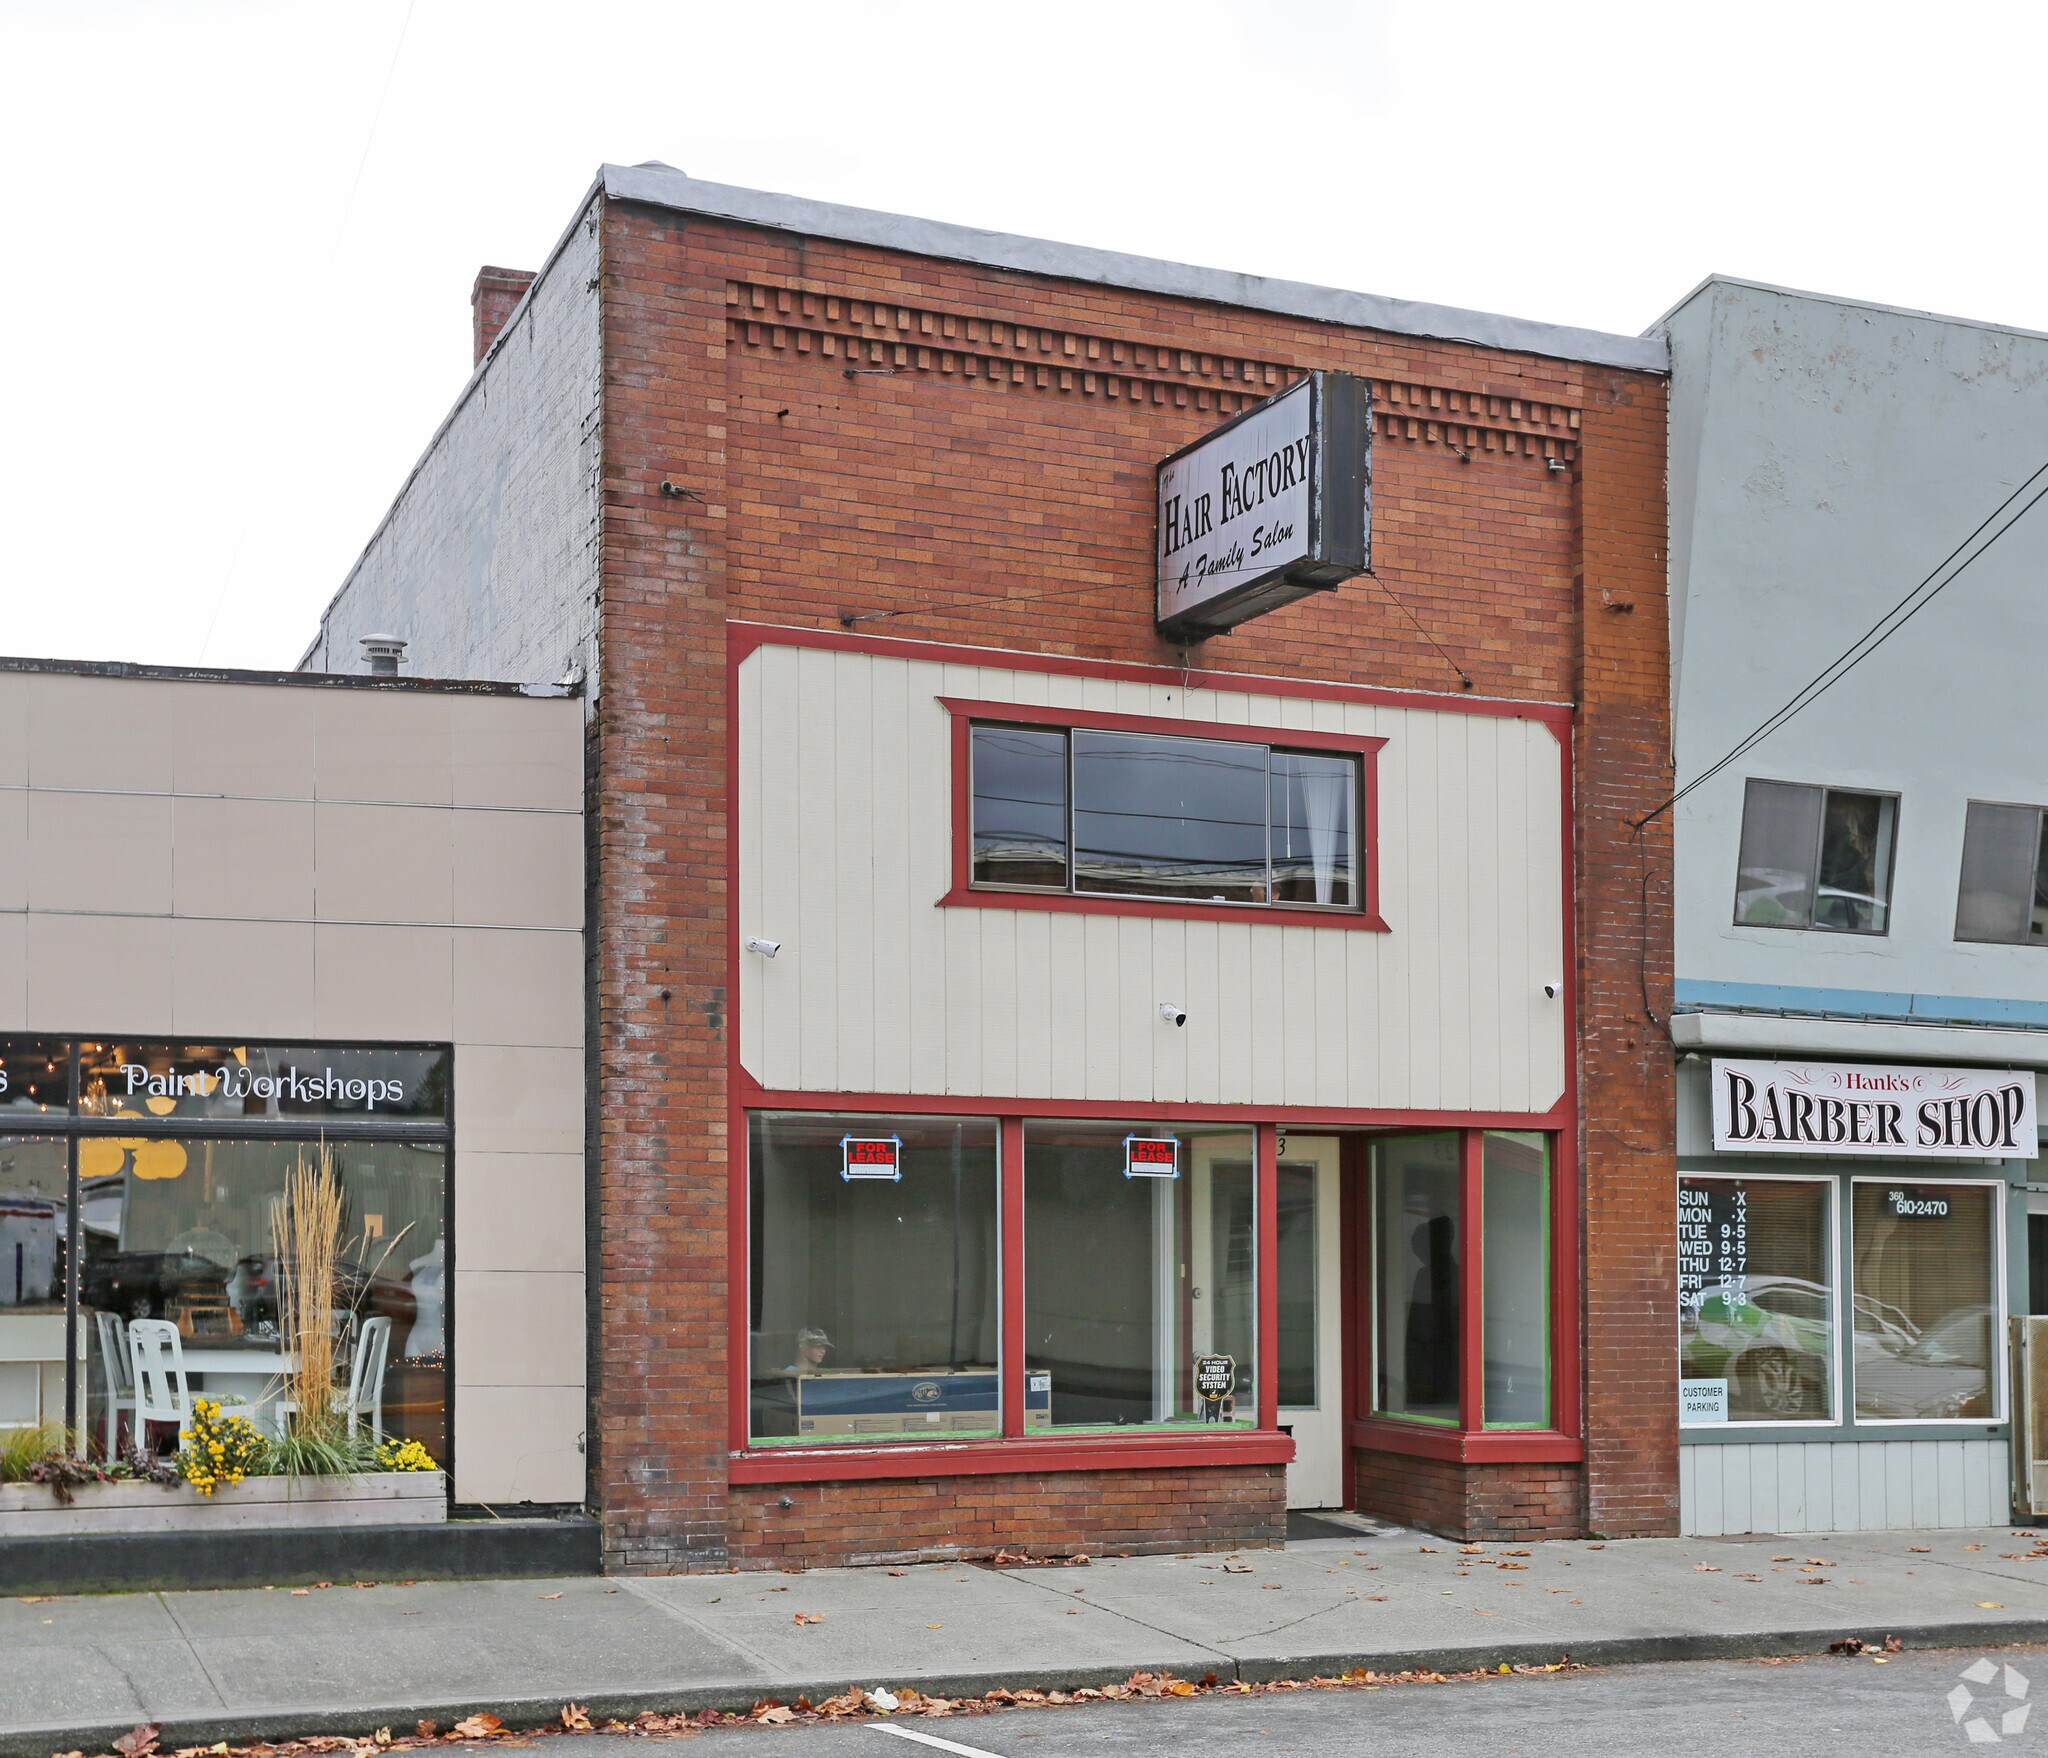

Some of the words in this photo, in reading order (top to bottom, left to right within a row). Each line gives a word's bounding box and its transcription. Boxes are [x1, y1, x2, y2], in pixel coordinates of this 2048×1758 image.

[1164, 493, 1213, 558] HAIR
[1220, 434, 1310, 526] FACTORY
[1176, 561, 1190, 595] A
[1195, 540, 1244, 588] Family
[1250, 519, 1294, 557] Salon
[119, 1063, 211, 1098] Paint
[215, 1066, 404, 1111] Workshops
[1846, 1072, 1910, 1092] Hank's
[1724, 1068, 1909, 1147] BARBER
[1915, 1082, 2027, 1151] SHOP
[856, 1142, 887, 1153] FOR
[1138, 1141, 1166, 1152] FOR
[847, 1151, 895, 1164] LEASE
[1130, 1151, 1174, 1163] LEASE
[1679, 1190, 1709, 1206] SUN
[1888, 1191, 1905, 1202] 360
[1679, 1207, 1712, 1223] MON
[1679, 1224, 1708, 1239] TUE
[1679, 1240, 1713, 1256] WED
[1679, 1257, 1710, 1272] THU
[1679, 1274, 1702, 1289] FRI
[1679, 1290, 1707, 1307] SAT
[1205, 1365, 1225, 1373] VIDEO
[1199, 1373, 1230, 1381] SECURITY
[1201, 1381, 1227, 1389] SYSTEM
[1682, 1387, 1723, 1397] CUSTOMER
[1687, 1402, 1720, 1412] PARKING
